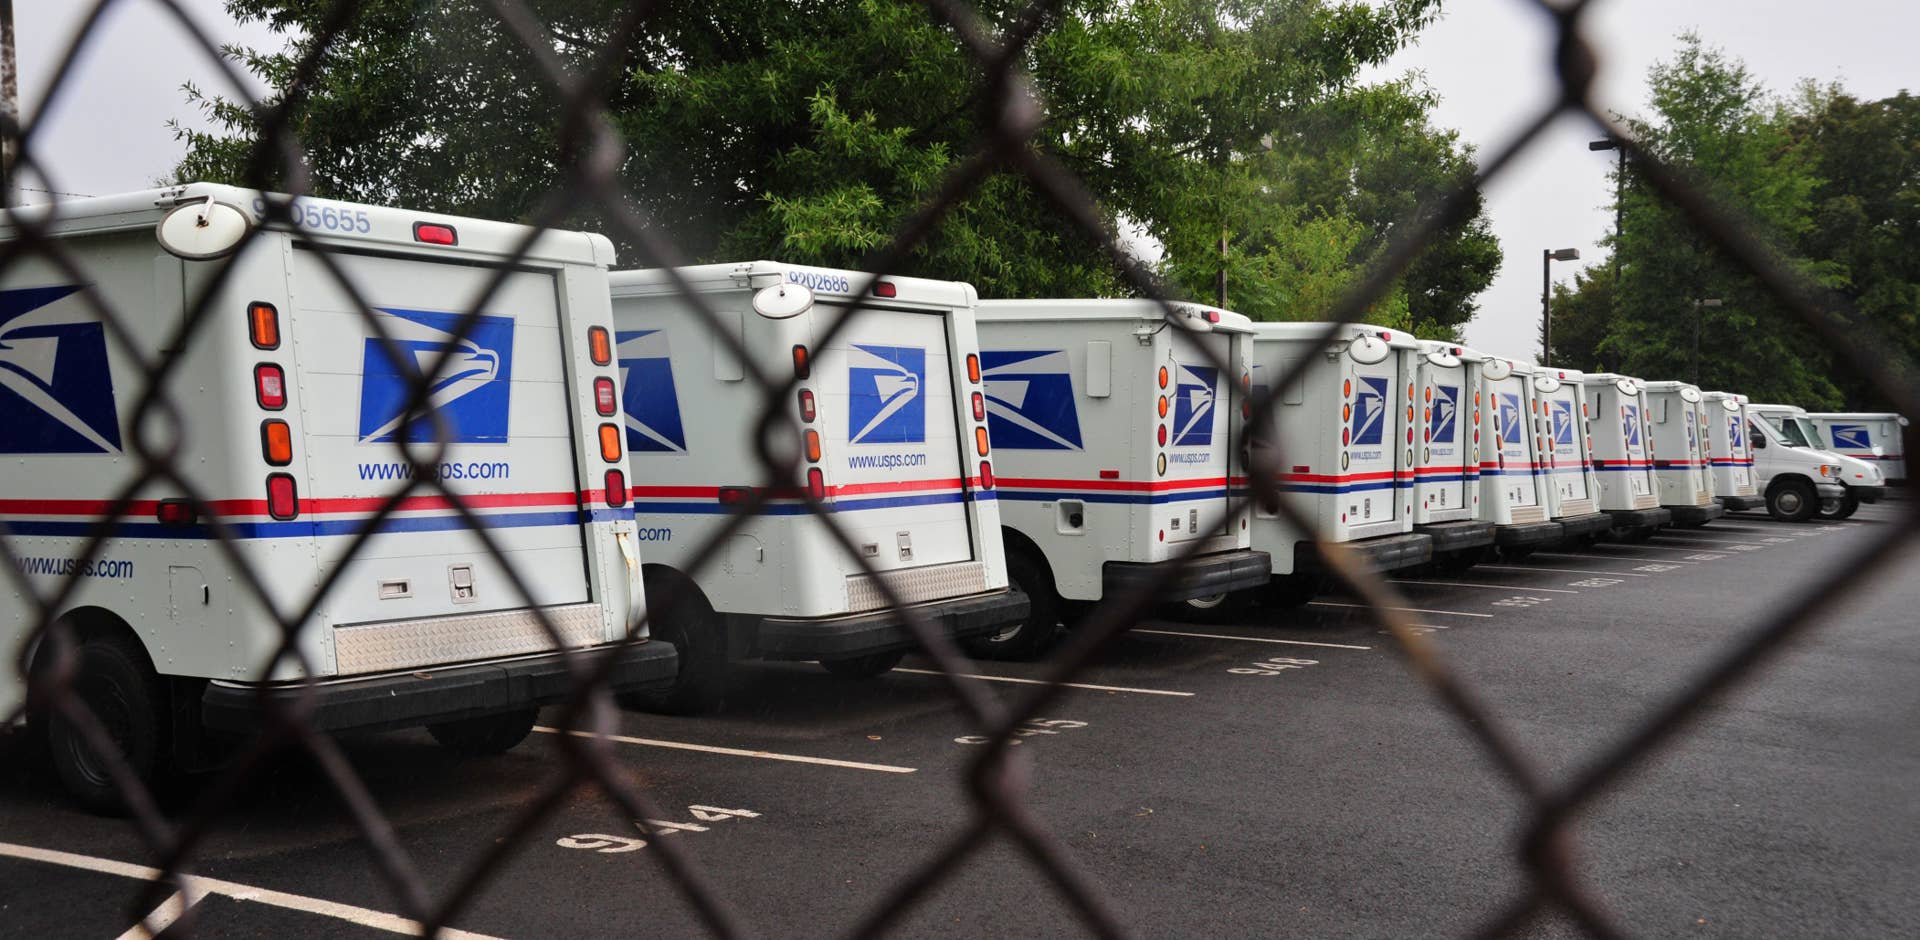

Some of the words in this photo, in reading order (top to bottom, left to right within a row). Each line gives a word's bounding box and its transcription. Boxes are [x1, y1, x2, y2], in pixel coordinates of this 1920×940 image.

[252, 197, 371, 233] 905655
[789, 271, 849, 293] 9202686
[848, 453, 926, 470] www.usps.com
[1226, 657, 1320, 676] 948
[556, 804, 763, 853] 944
